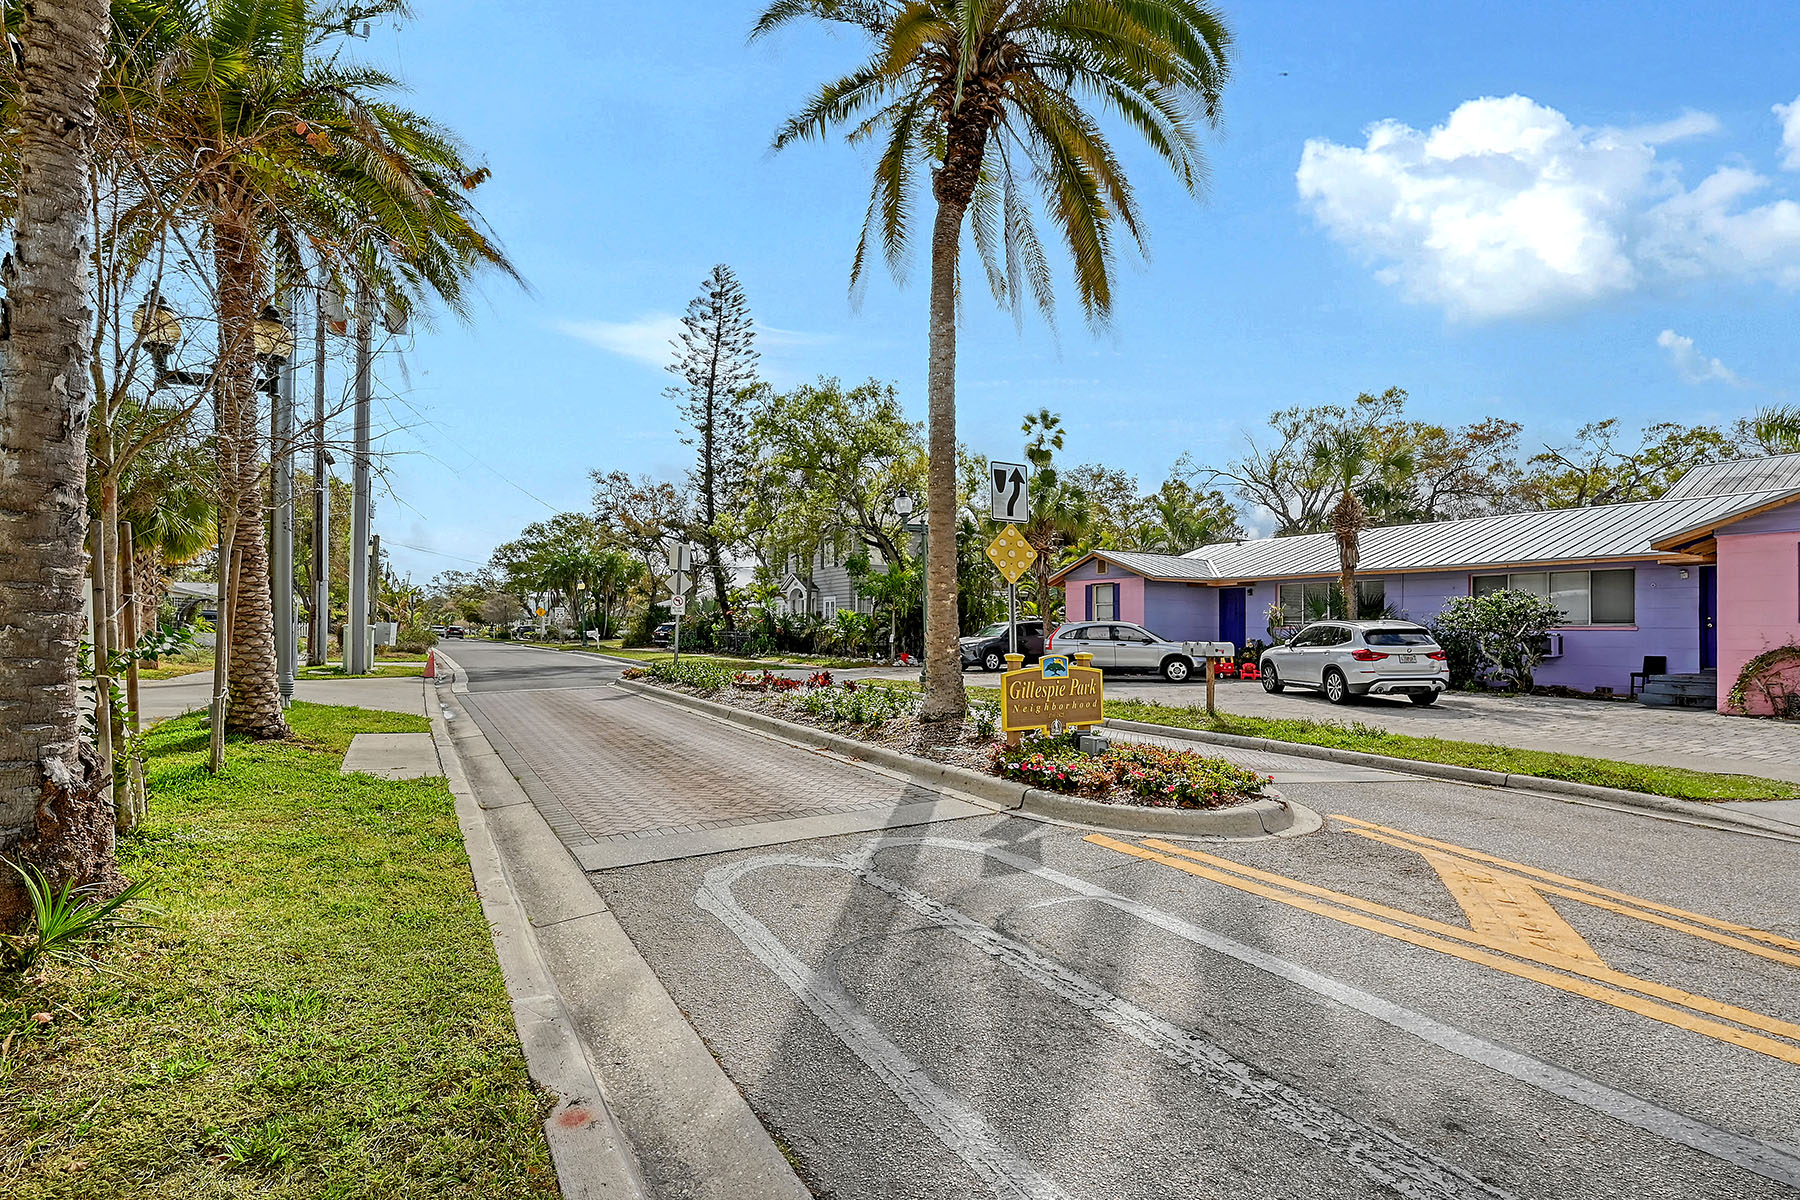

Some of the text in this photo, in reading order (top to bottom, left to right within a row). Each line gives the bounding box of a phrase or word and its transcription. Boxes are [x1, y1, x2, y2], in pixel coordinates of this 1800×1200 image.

[1009, 678, 1096, 702] Gillespie Park
[1012, 699, 1098, 714] Neighborhood
